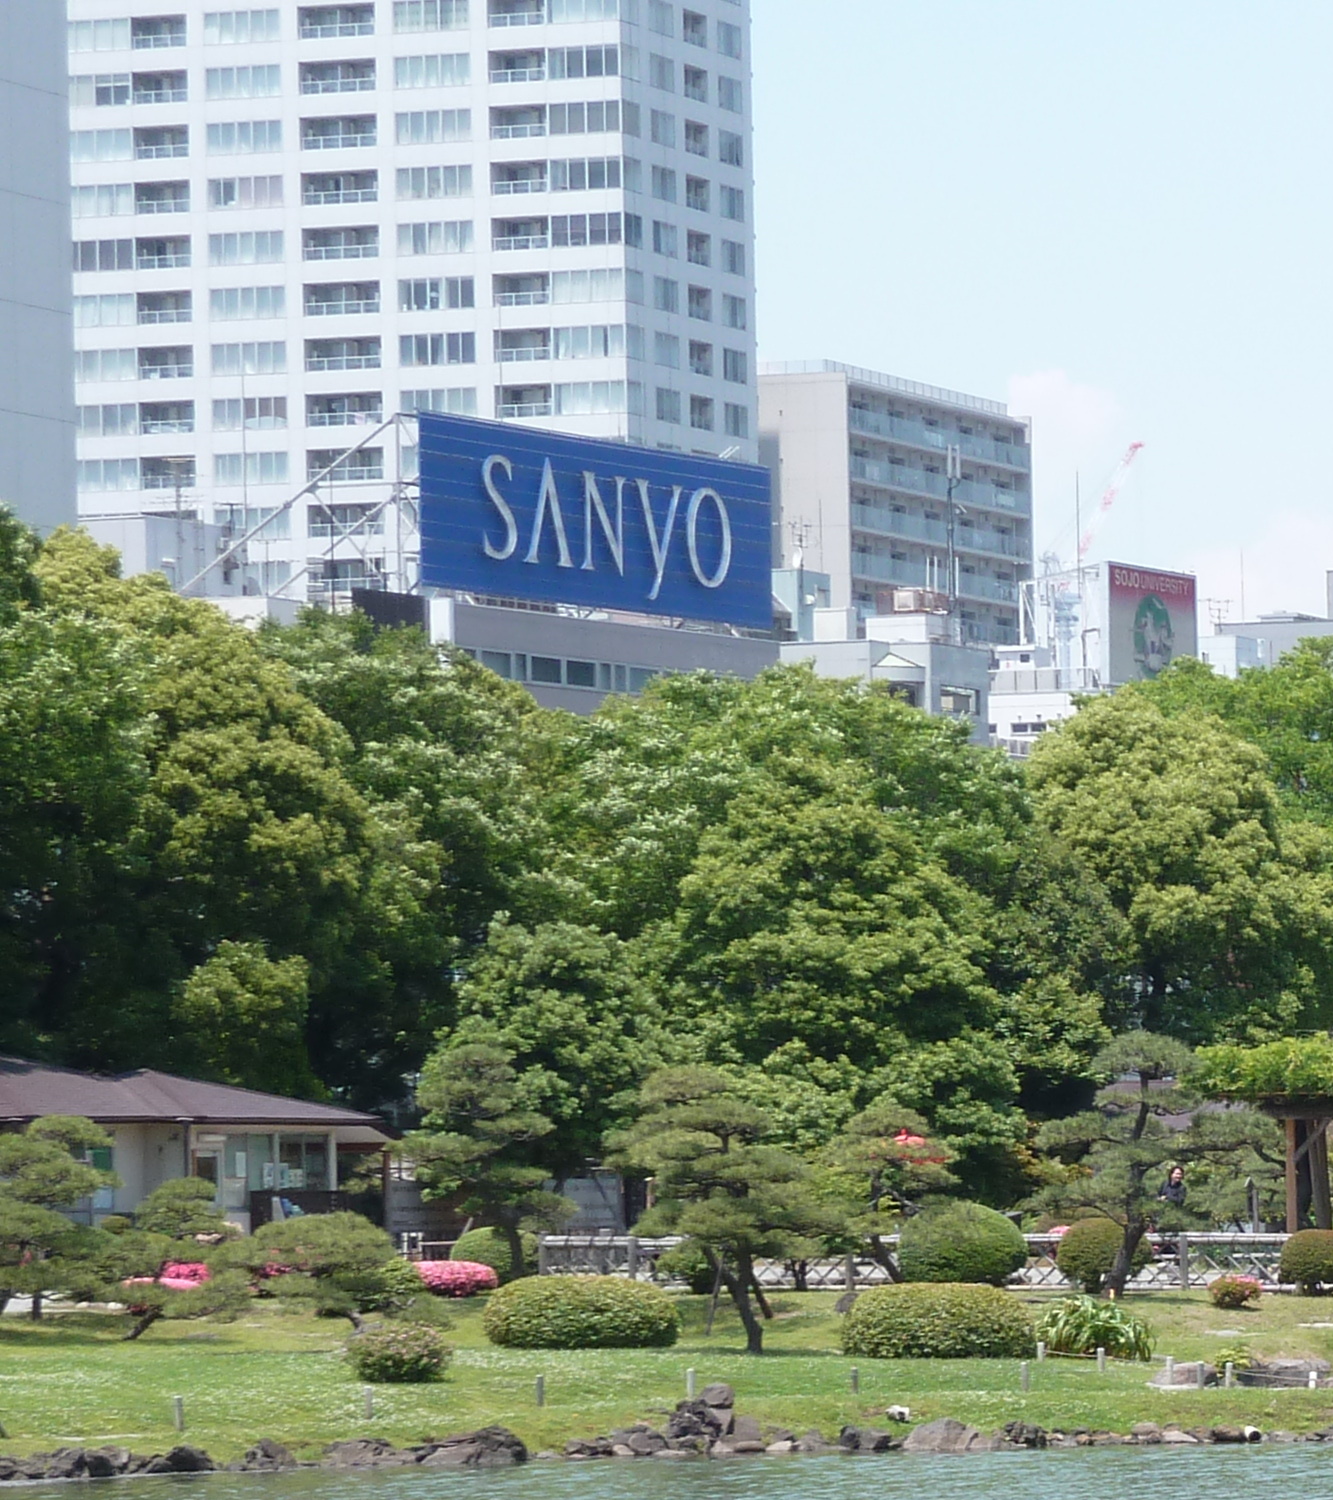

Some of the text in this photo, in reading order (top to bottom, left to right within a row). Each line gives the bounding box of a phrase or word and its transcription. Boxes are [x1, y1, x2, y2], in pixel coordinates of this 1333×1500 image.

[482, 454, 732, 600] SANYO
[1114, 569, 1188, 594] SOJO UNIVERSITY
